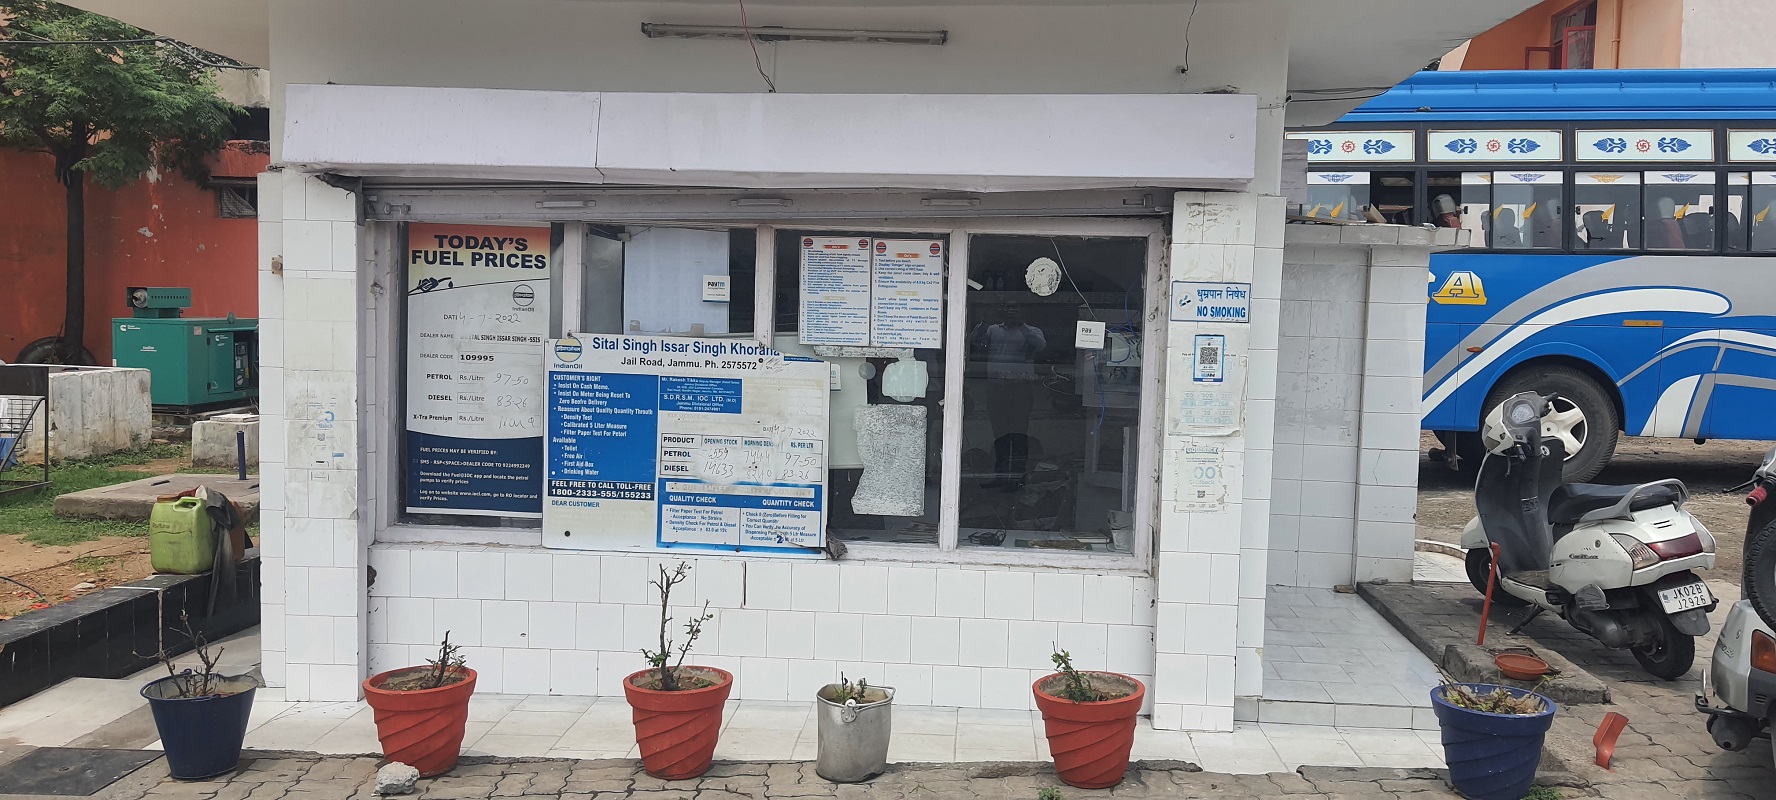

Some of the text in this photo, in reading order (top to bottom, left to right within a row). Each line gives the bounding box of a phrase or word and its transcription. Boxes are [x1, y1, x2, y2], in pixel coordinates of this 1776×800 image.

[434, 235, 528, 251] TODAY'S
[412, 250, 546, 270] FUEL PRICES
[1427, 271, 1487, 305] A
[1197, 306, 1246, 318] NO SMOKING
[592, 336, 618, 350] Sital
[623, 338, 656, 354] Singh
[661, 340, 690, 352] Issar
[693, 341, 726, 356] Singh
[621, 357, 756, 370] Jail Road, Jammu. Ph. 2575572
[429, 415, 452, 423] Premium
[552, 488, 651, 499] 1800-2333-555/155233
